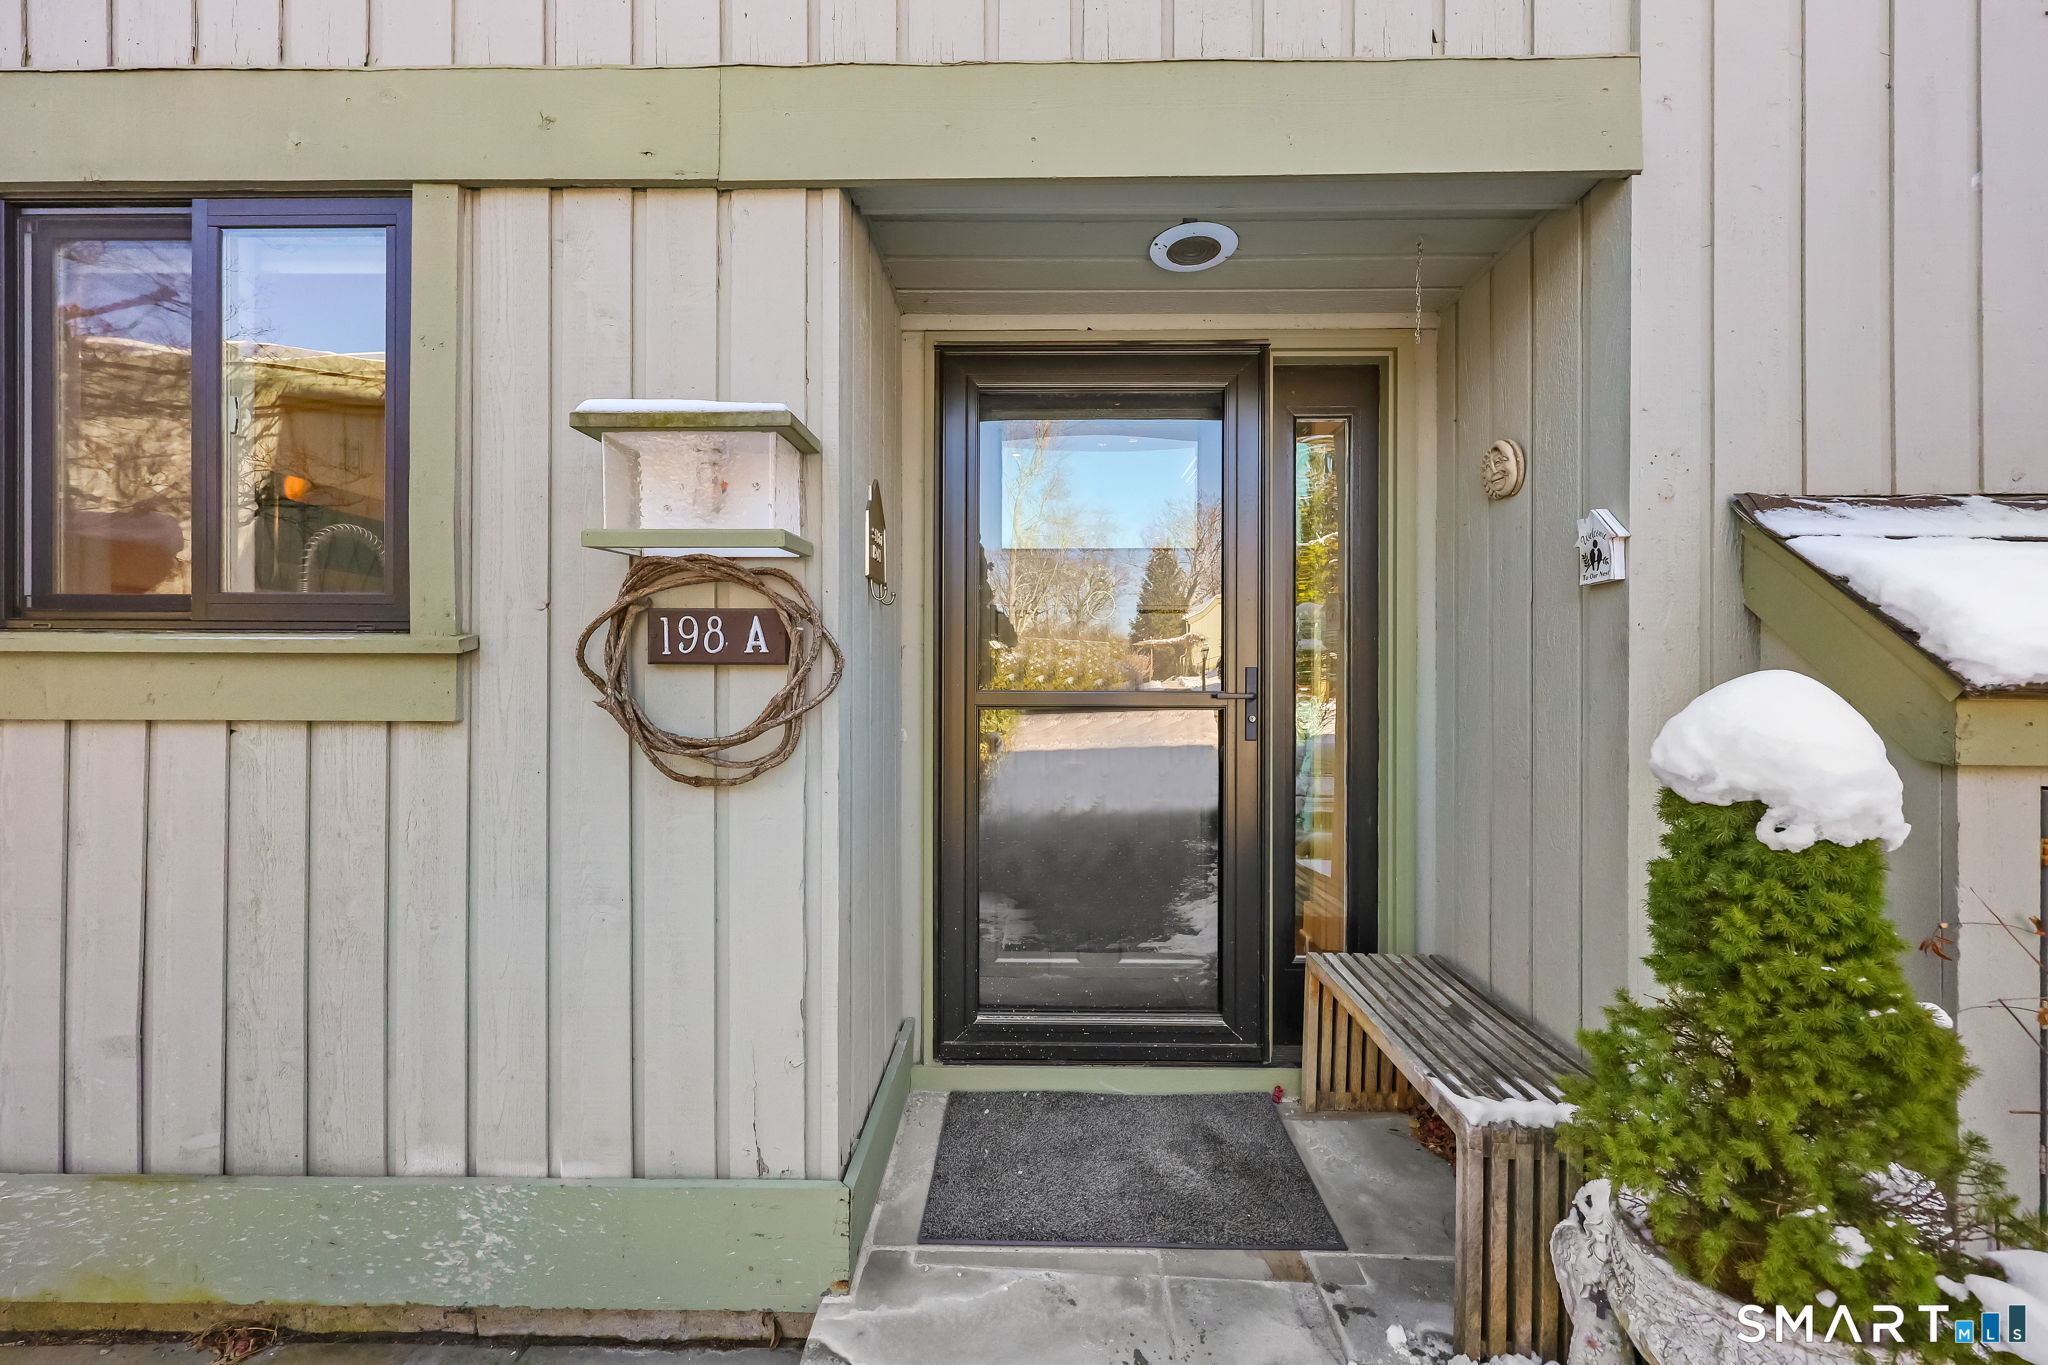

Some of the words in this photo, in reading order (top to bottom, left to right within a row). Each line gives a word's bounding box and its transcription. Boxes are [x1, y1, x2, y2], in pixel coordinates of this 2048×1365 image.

[1580, 527, 1607, 545] Welcome
[660, 615, 725, 655] 198
[744, 615, 769, 653] A
